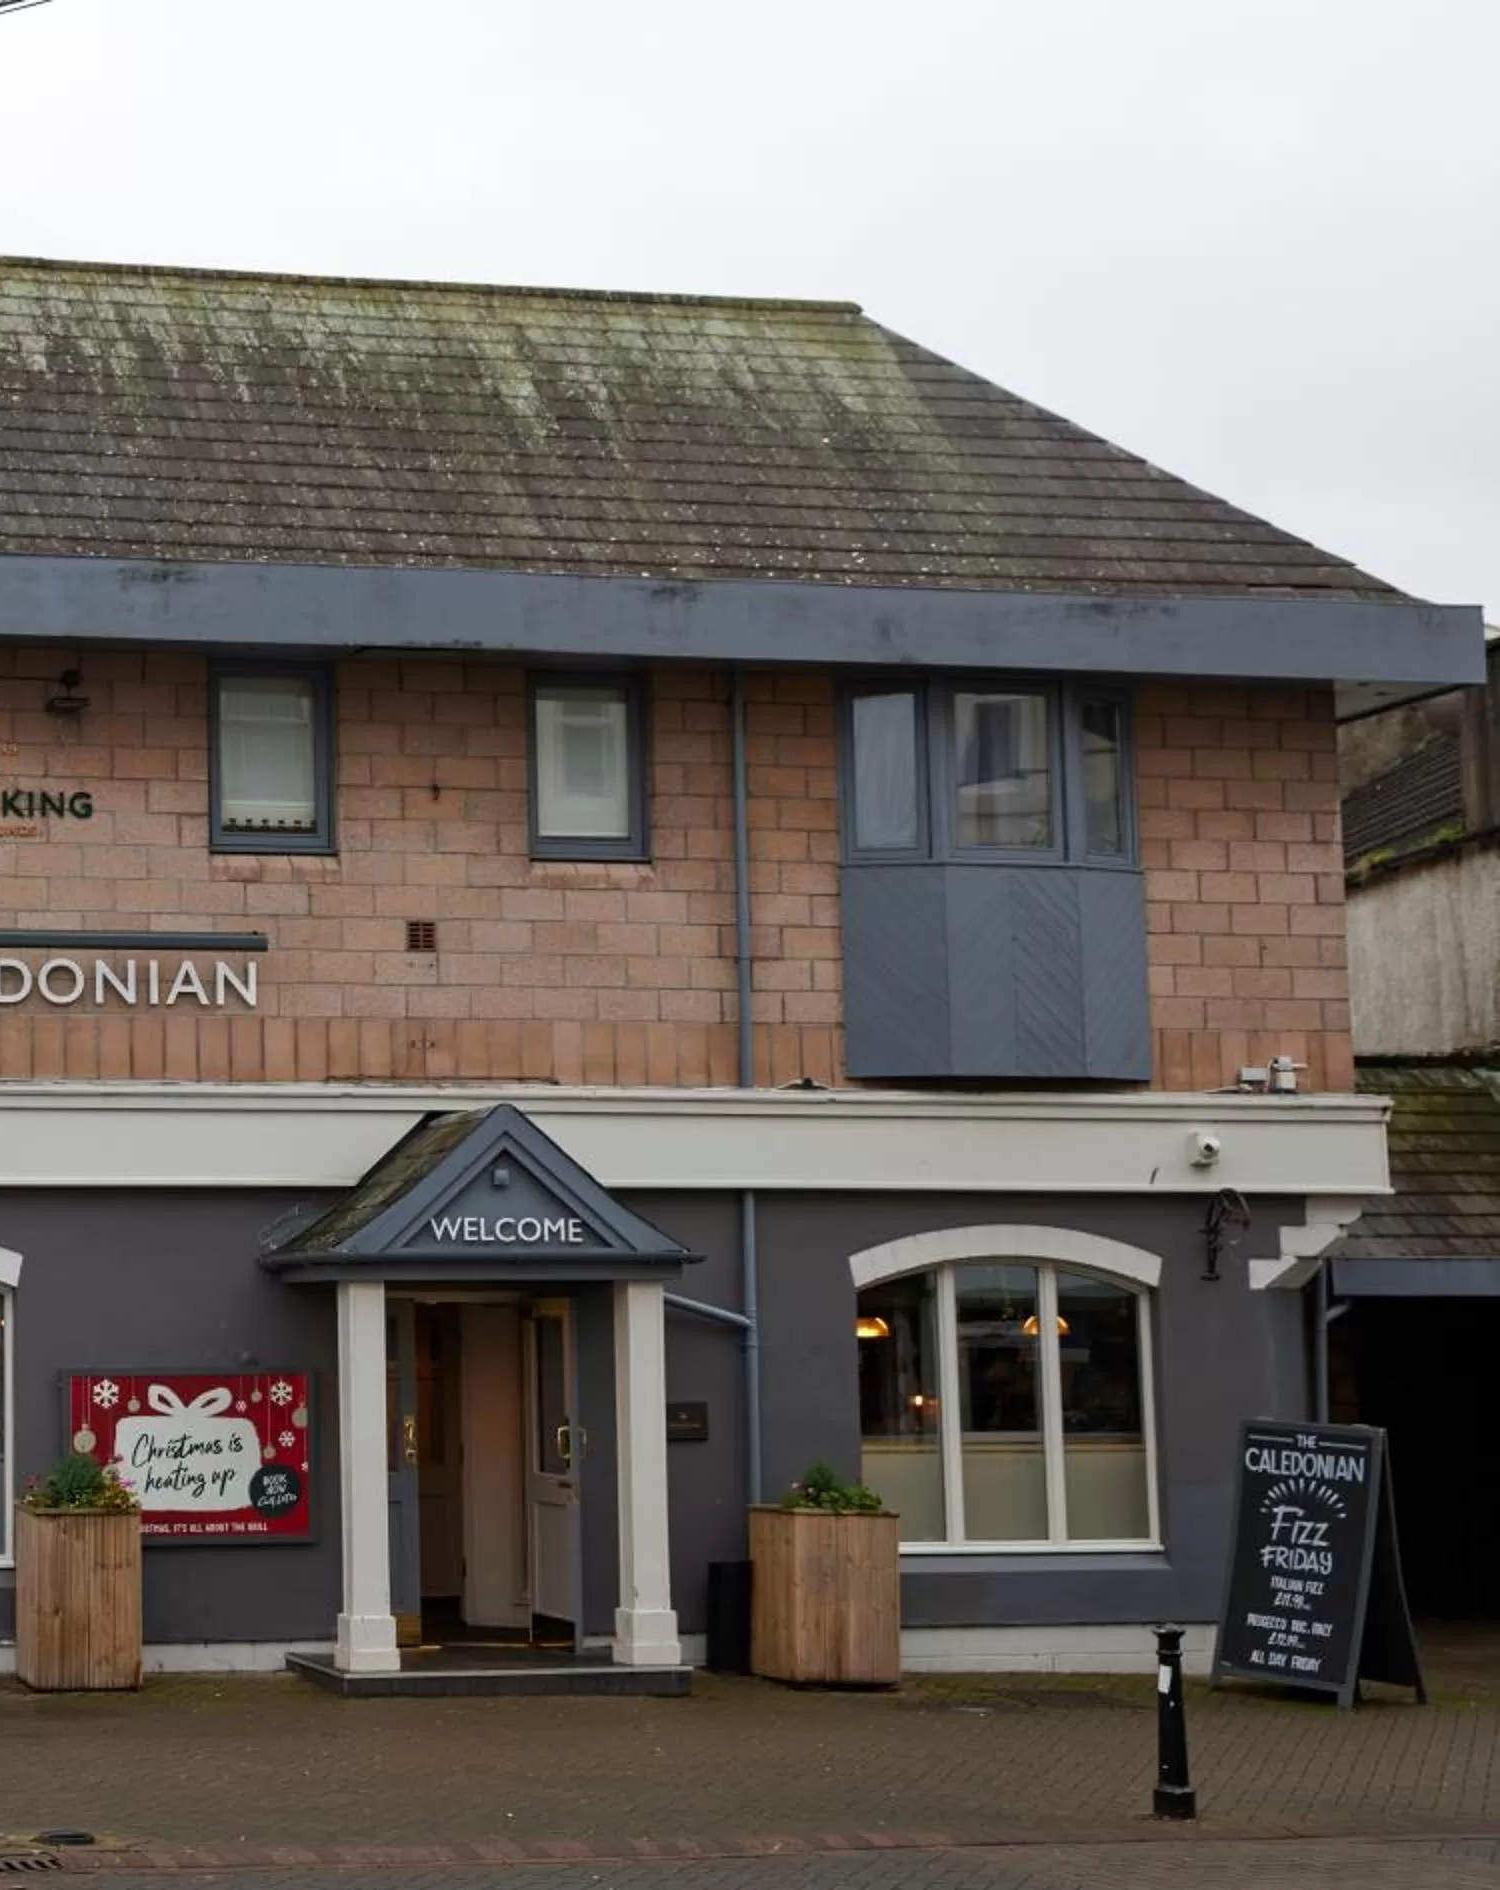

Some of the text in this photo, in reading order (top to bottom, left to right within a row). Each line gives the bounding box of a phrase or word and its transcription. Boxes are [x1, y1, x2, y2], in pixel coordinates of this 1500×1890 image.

[1, 790, 94, 819] KING
[430, 1216, 584, 1244] WELCOME
[131, 1432, 244, 1468] Christmas is
[1296, 1434, 1318, 1449] THE
[1245, 1447, 1365, 1483] CALEDONIAN
[143, 1462, 237, 1498] heating up
[1260, 1545, 1333, 1575] FRIDAY
[1249, 1649, 1265, 1665] ALL
